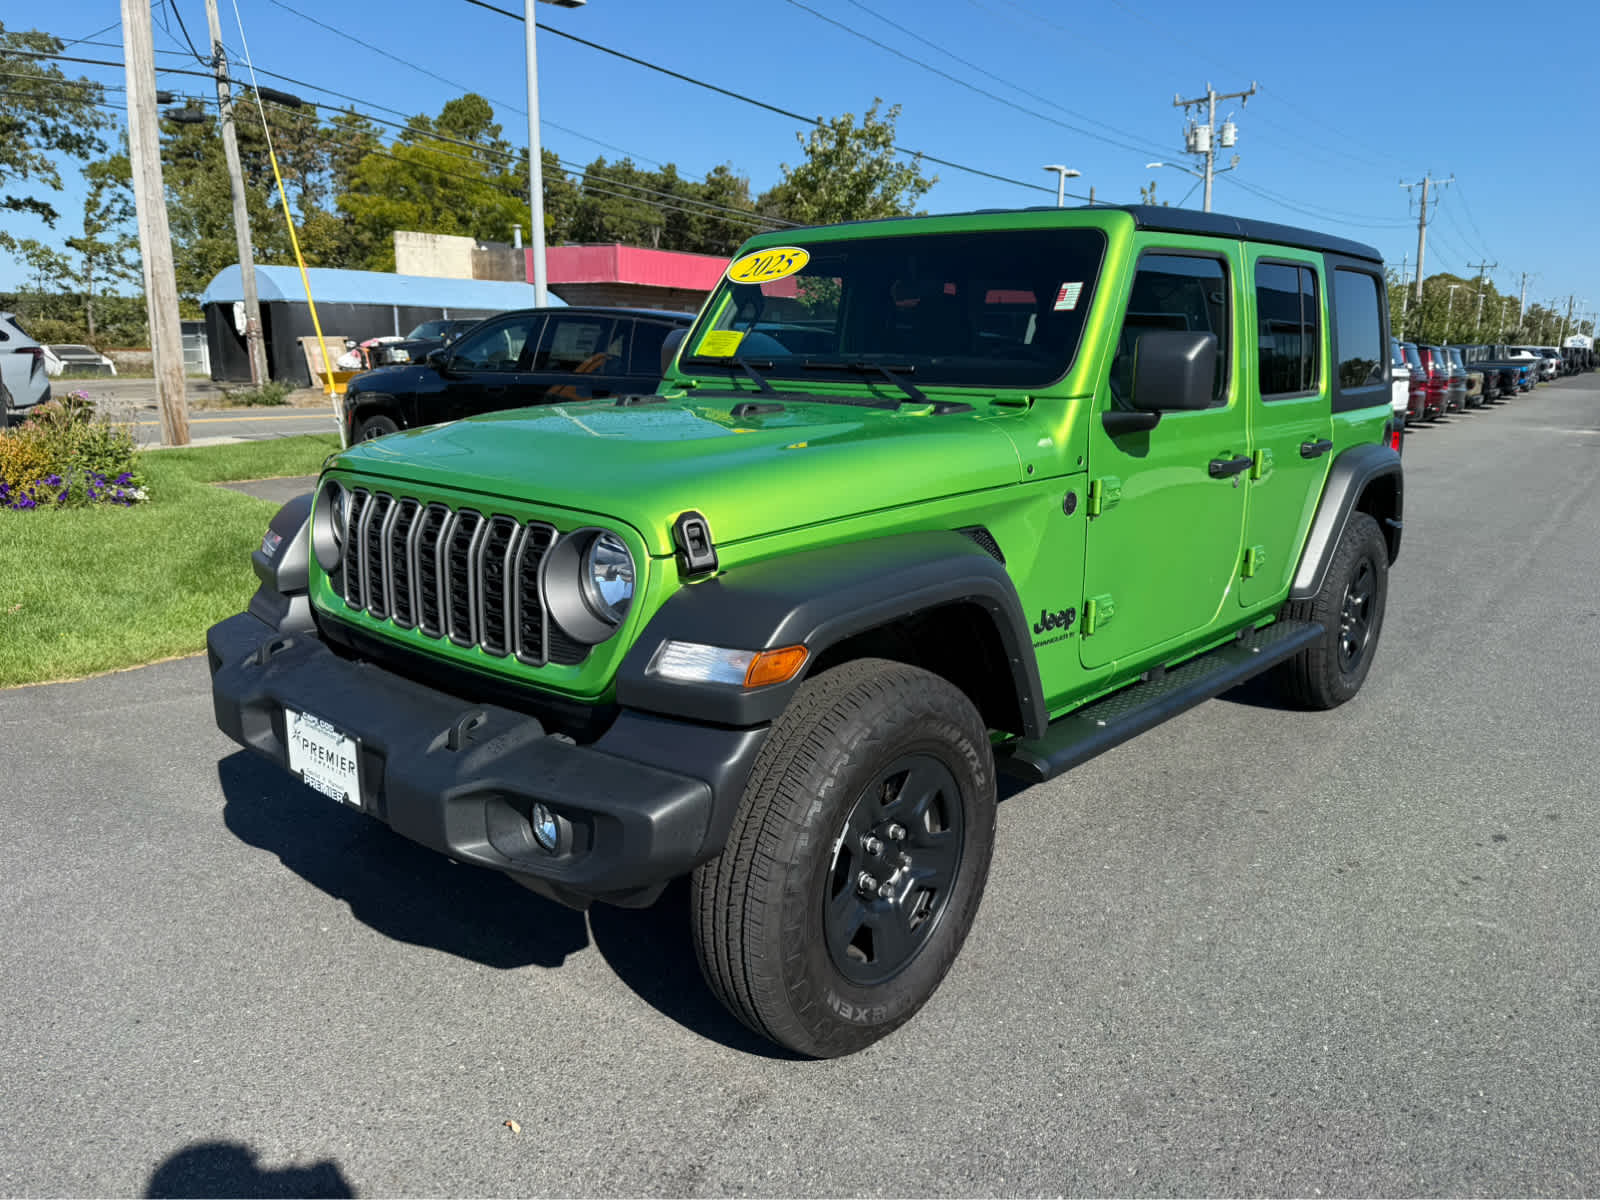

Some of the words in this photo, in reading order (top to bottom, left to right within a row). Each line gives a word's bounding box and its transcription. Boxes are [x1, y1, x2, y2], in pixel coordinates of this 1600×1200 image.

[739, 252, 801, 278] 2025
[1033, 607, 1076, 635] Jeep
[302, 738, 356, 774] PREMIER
[303, 774, 345, 804] PREMIER
